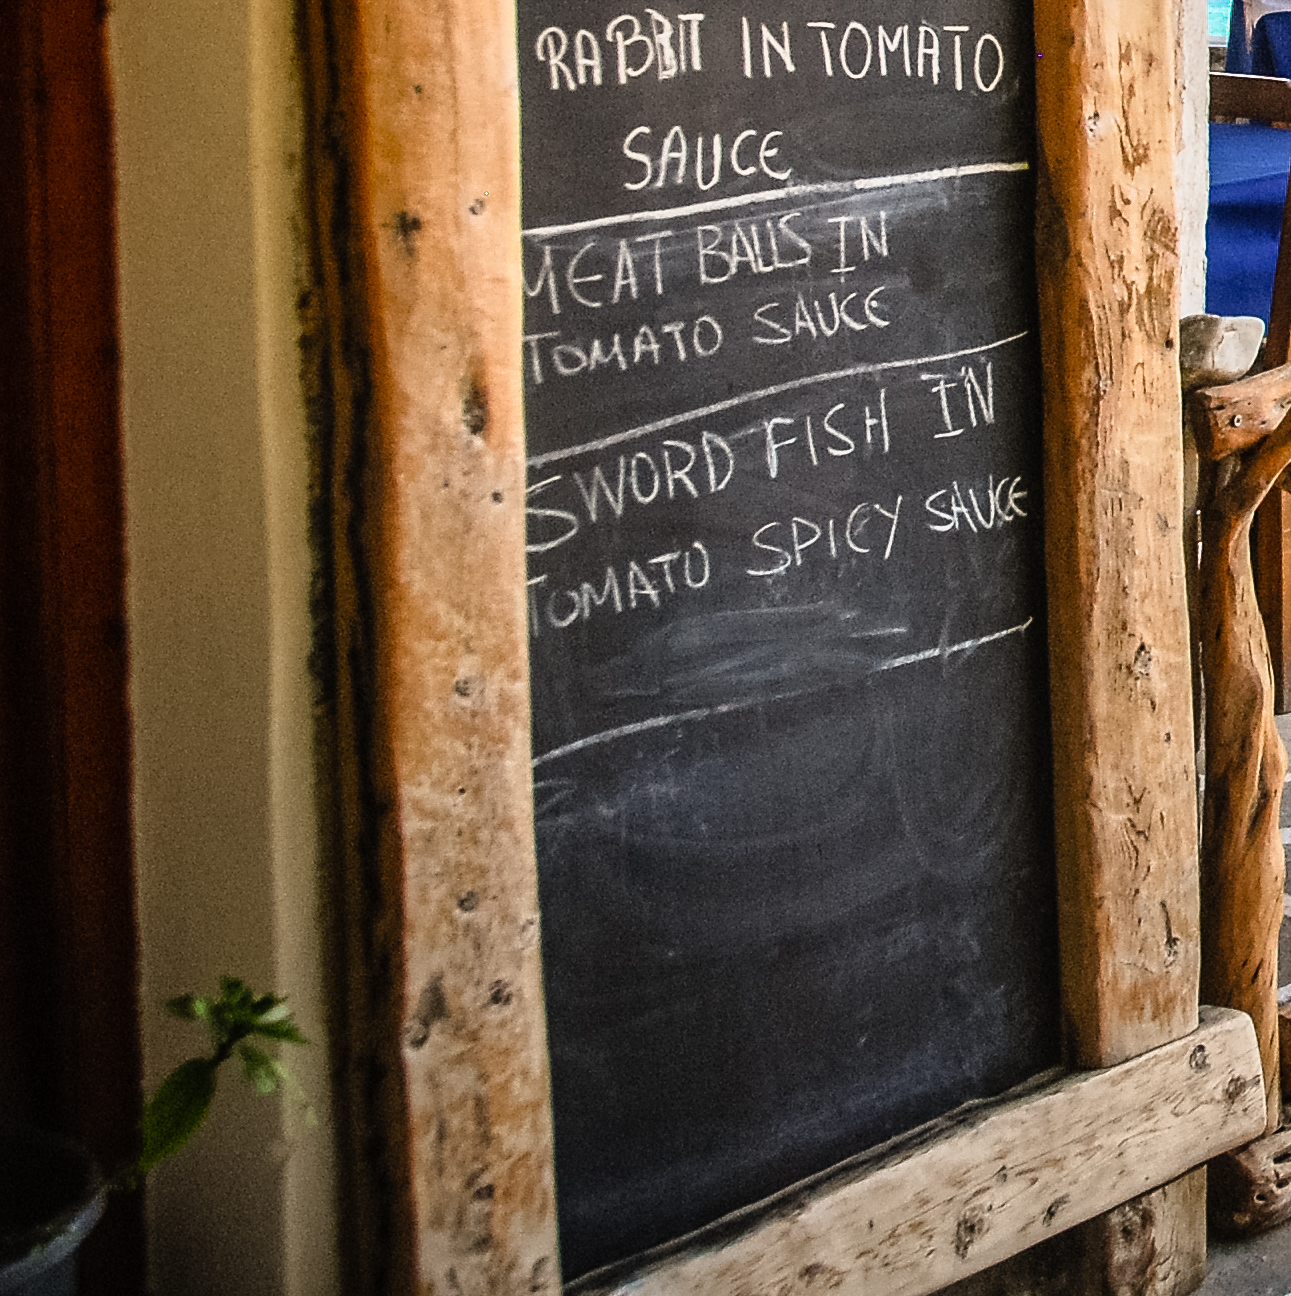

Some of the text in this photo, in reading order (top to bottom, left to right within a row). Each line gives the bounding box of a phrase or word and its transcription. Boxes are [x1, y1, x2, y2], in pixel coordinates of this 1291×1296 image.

[741, 16, 797, 78] IN
[806, 20, 1005, 93] TOMATO
[623, 125, 794, 191] SAUCE
[697, 212, 812, 285] BALLS
[828, 211, 889, 274] IN
[523, 286, 891, 385] TOMATO SAUCE
[525, 361, 996, 554] SWORD FISH IN
[526, 475, 1029, 637] TOMATO SPICY SAUCE
